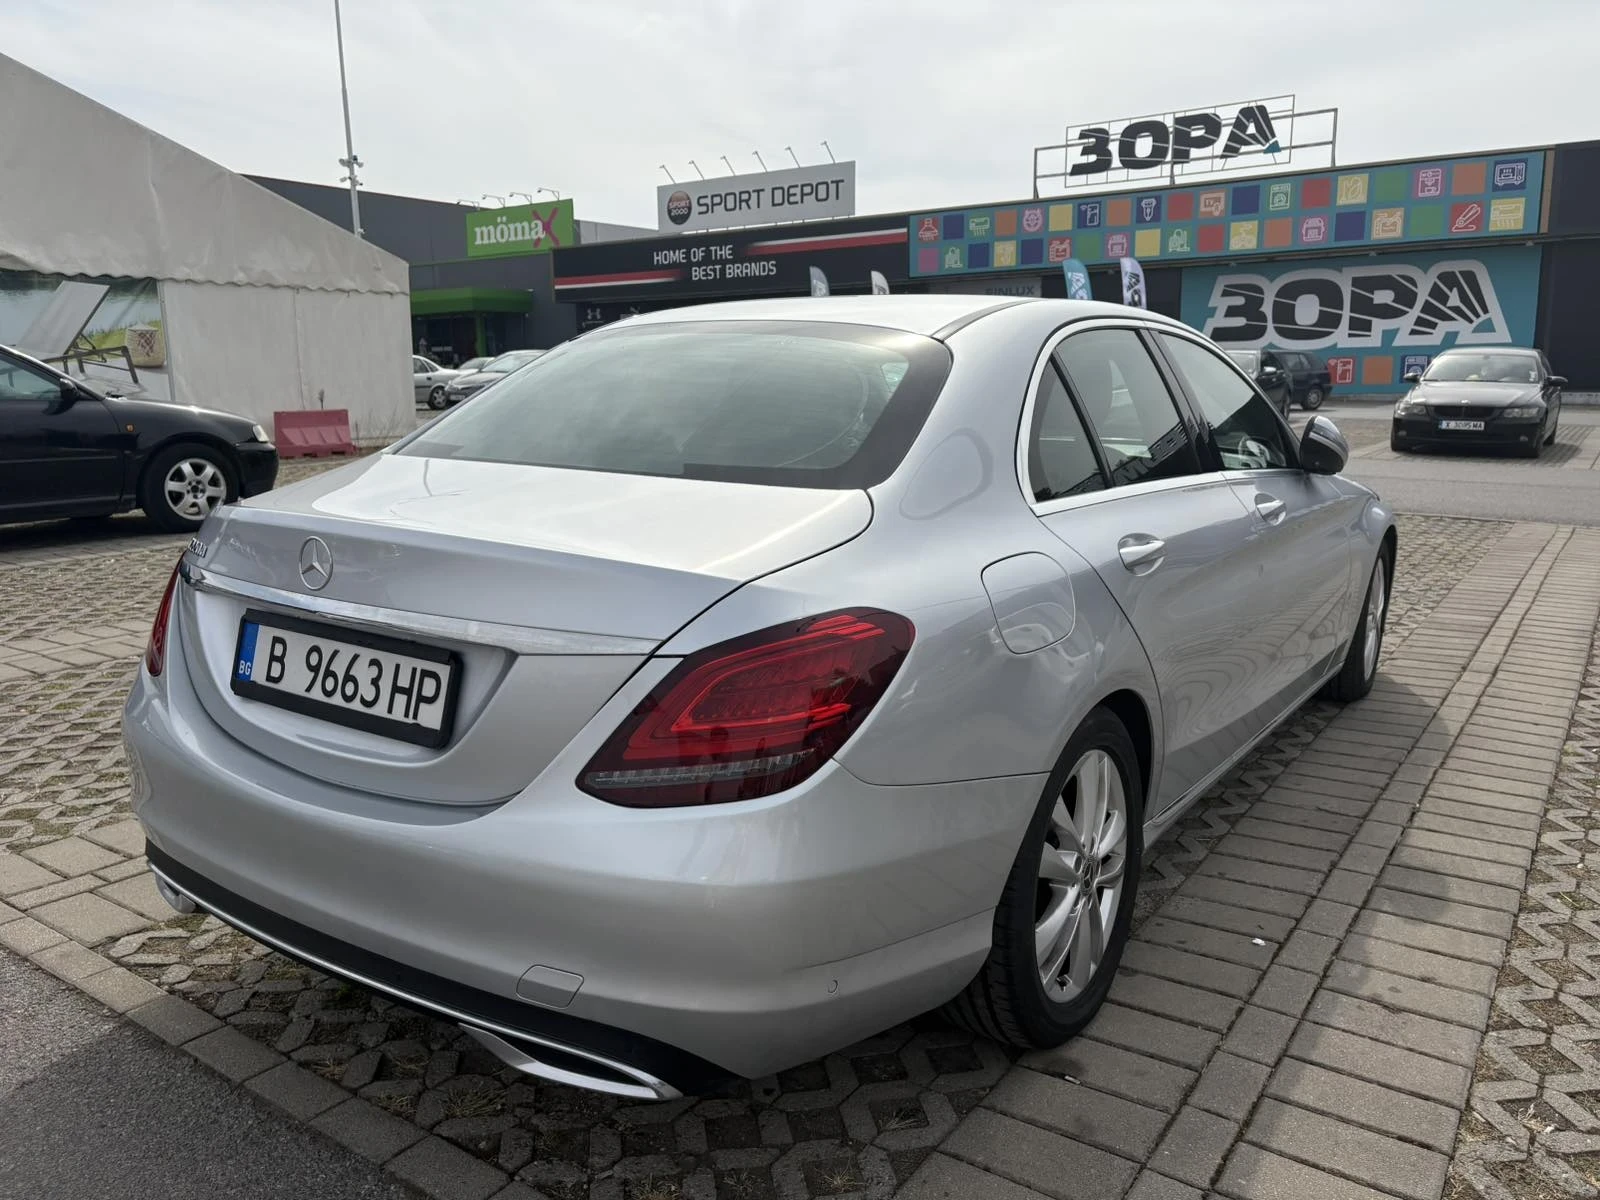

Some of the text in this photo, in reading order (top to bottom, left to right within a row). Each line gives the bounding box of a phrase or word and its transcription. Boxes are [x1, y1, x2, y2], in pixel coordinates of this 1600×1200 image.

[1069, 104, 1281, 176] ЗОРА
[696, 179, 845, 216] SPORT DEPOT
[653, 245, 733, 265] HOME OF THE
[691, 261, 777, 280] BEST BRANDS
[1205, 262, 1506, 346] ЗОРА
[238, 659, 252, 675] BG
[265, 635, 288, 684] B
[304, 645, 384, 708] 9663
